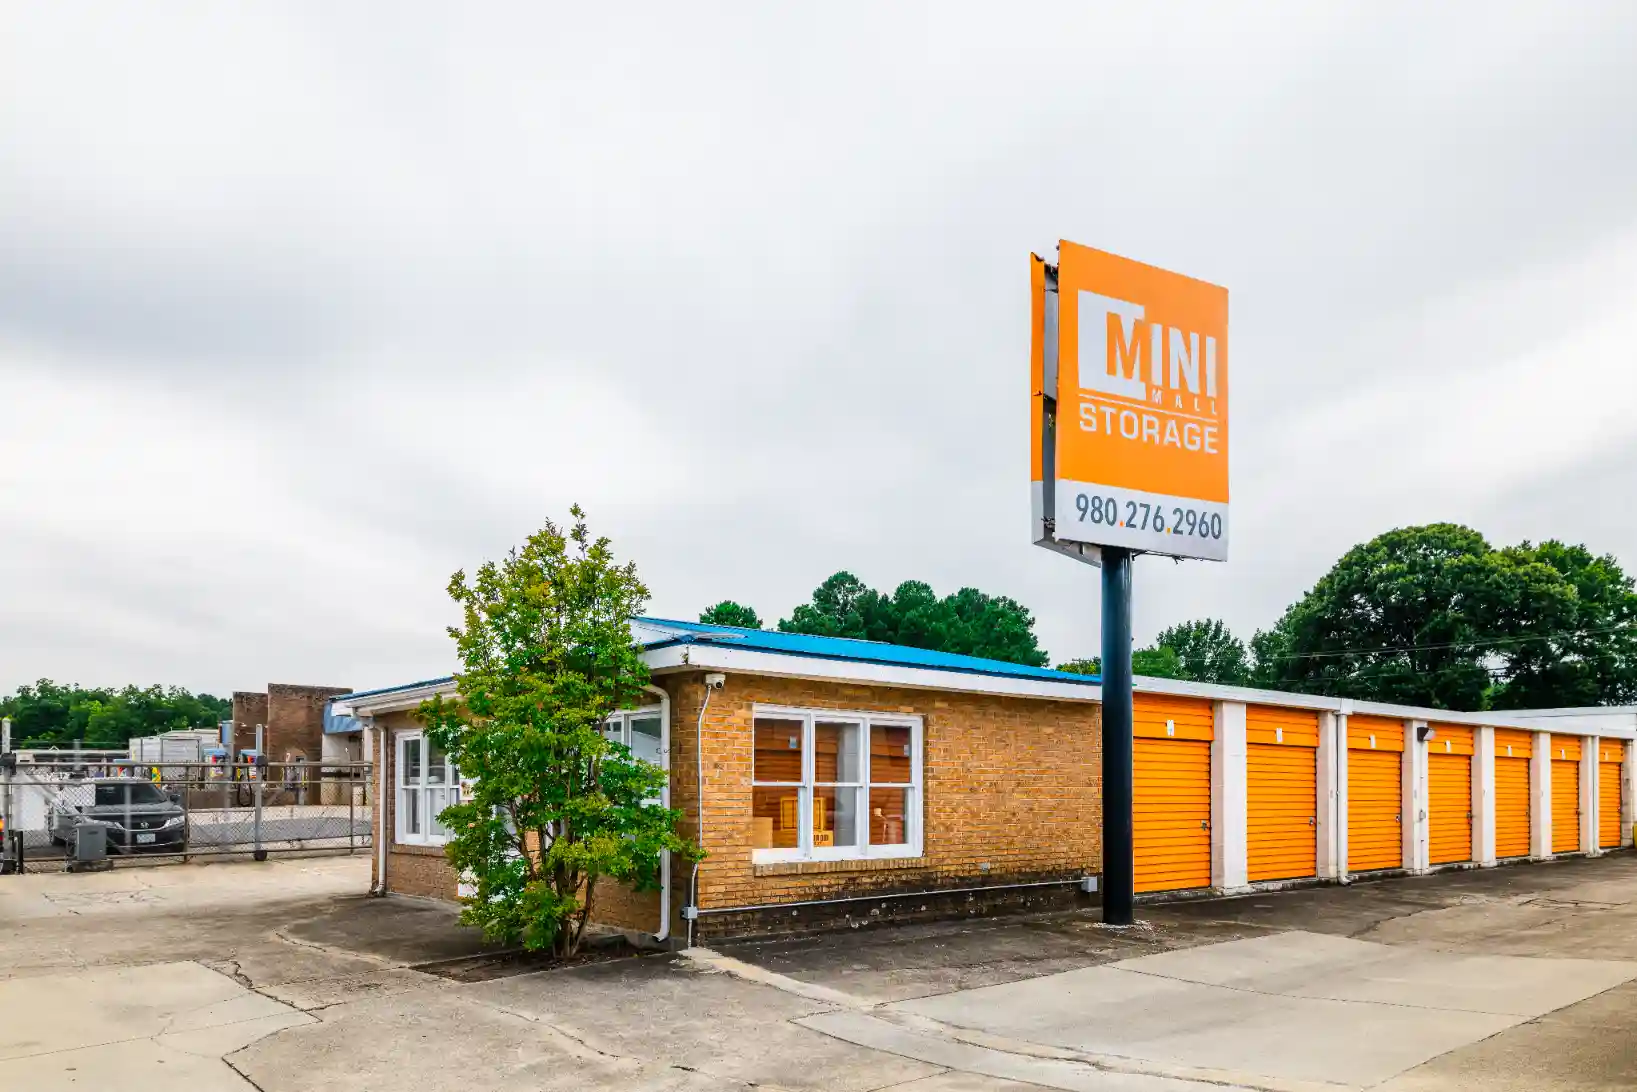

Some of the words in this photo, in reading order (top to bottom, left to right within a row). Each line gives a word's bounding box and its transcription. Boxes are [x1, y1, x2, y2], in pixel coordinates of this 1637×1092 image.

[1106, 311, 1217, 398] MINI
[1152, 388, 1217, 415] MALL
[1079, 402, 1219, 454] STORAGE
[1075, 493, 1222, 539] 980.276.2960
